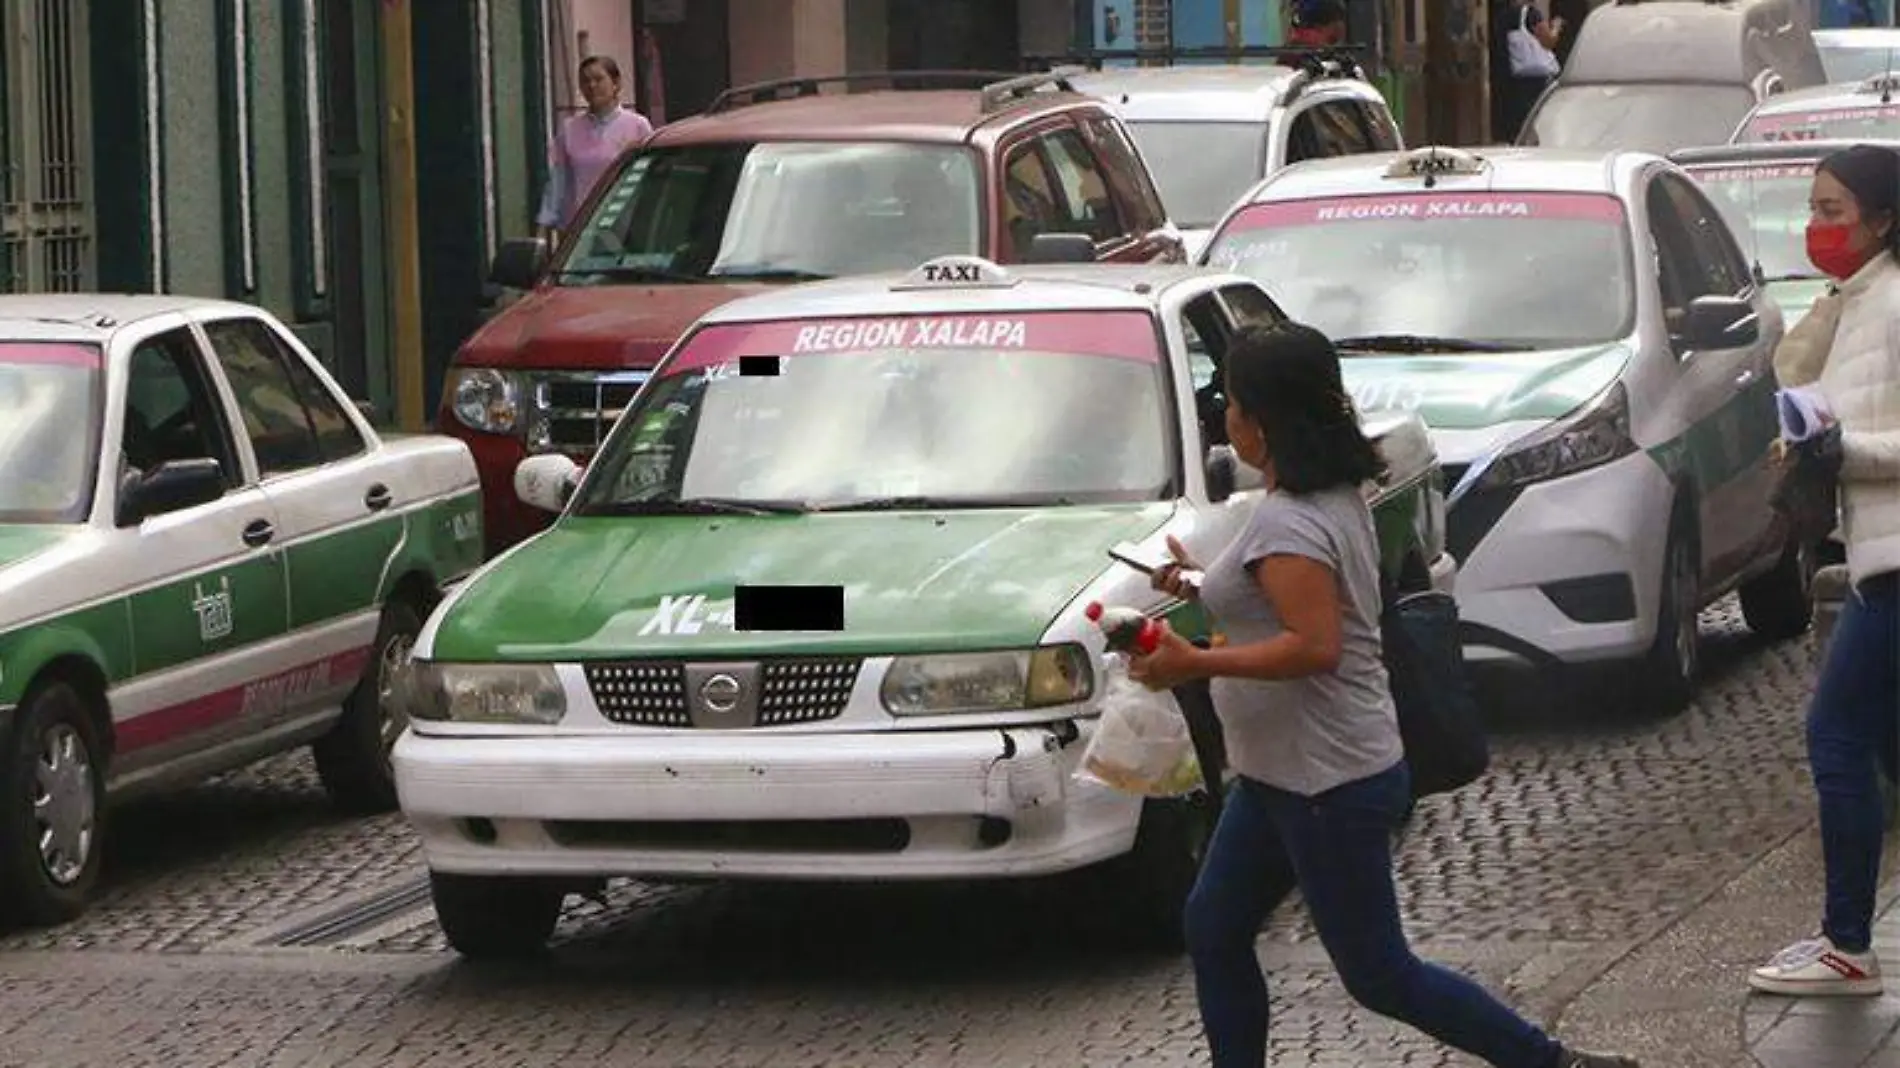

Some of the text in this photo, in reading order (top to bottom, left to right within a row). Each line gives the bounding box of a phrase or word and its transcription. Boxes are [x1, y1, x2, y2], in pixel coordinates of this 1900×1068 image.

[1316, 202, 1529, 221] REGION XALAPA
[923, 264, 982, 282] TAXI
[794, 320, 1027, 353] REGION XALAPA
